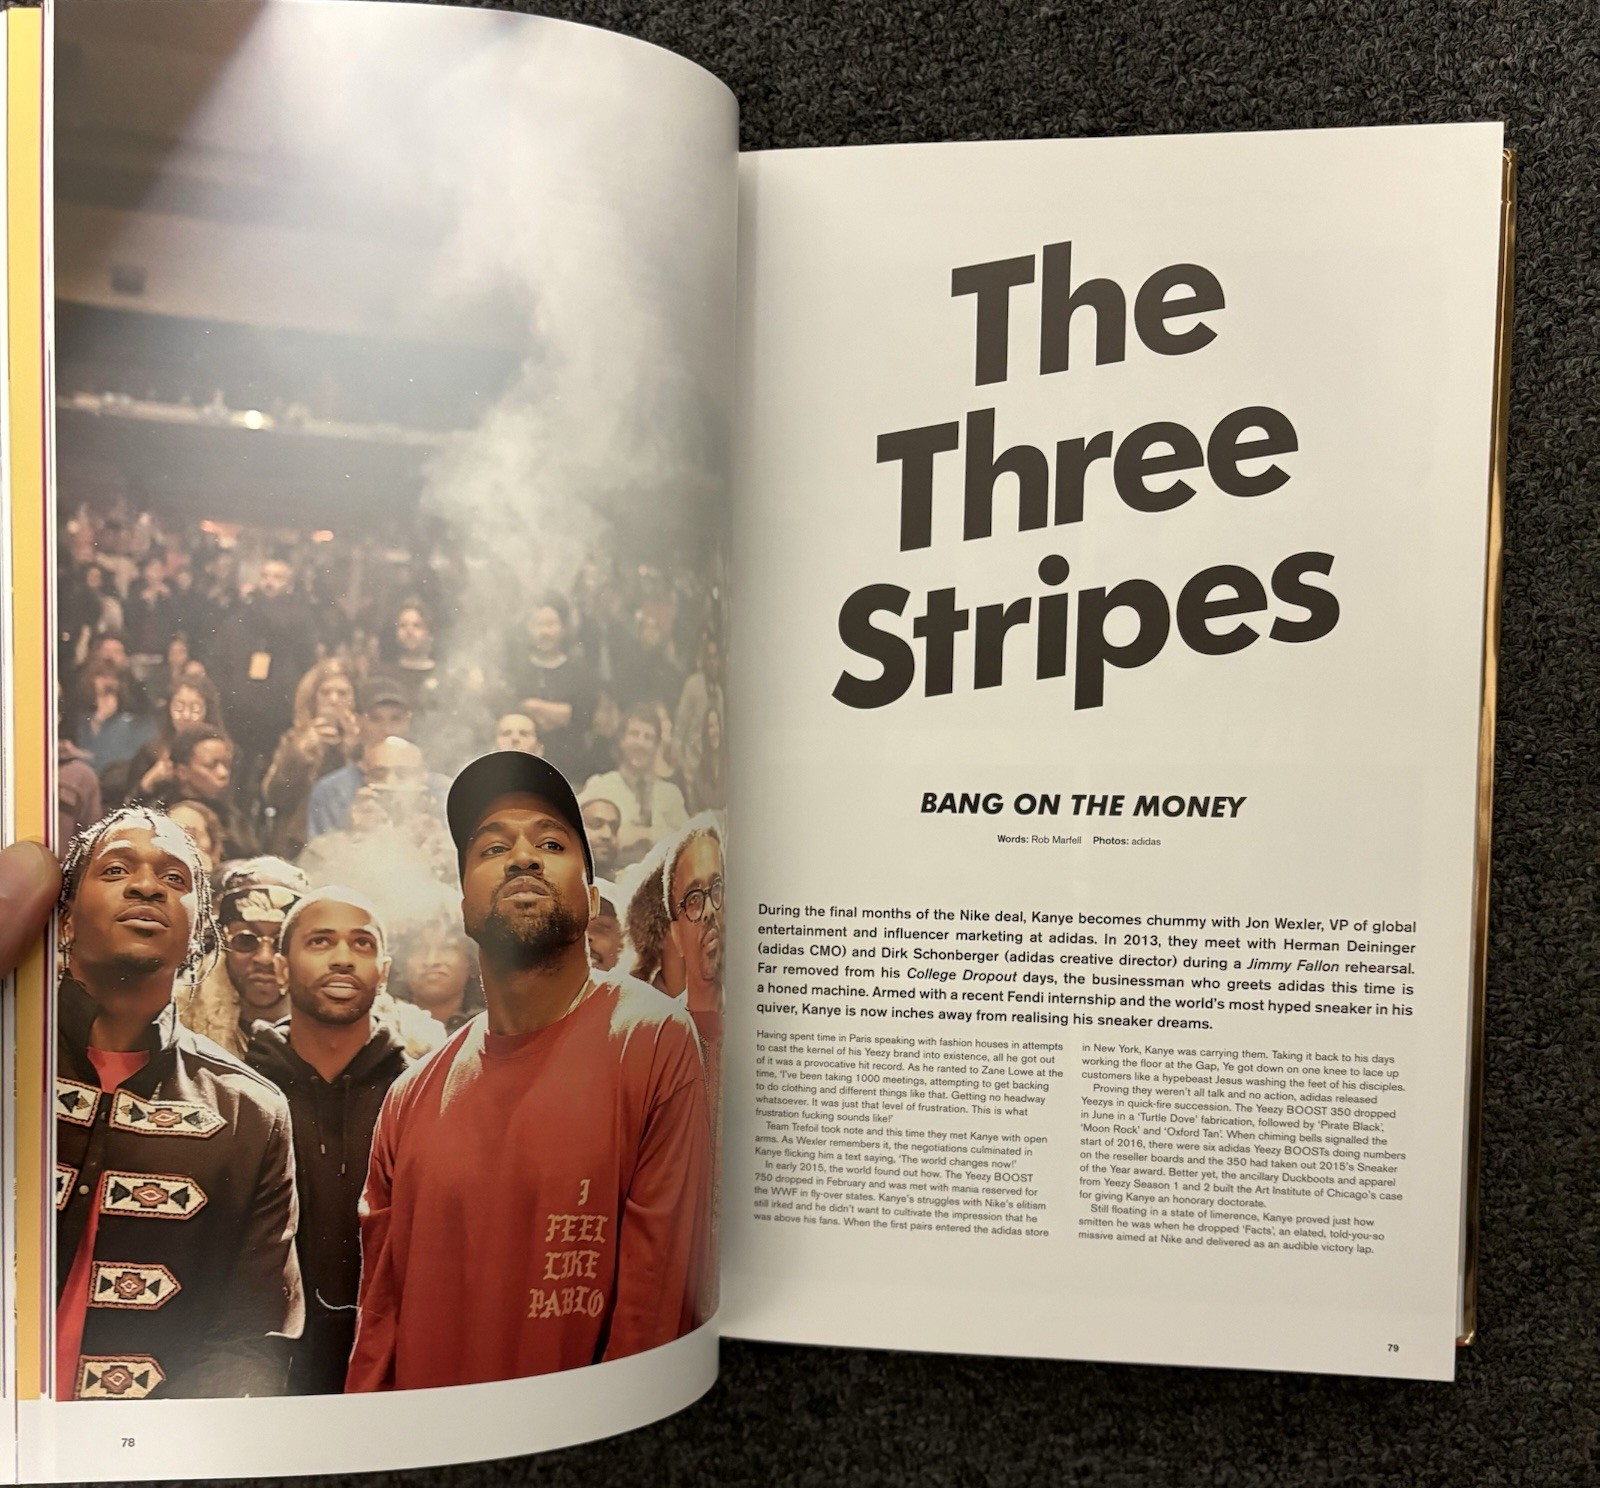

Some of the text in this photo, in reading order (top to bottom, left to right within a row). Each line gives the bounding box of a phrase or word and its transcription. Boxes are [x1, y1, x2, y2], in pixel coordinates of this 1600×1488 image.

[951, 240, 1226, 387] The
[876, 407, 1299, 552] Three
[831, 551, 1340, 711] Stripes
[920, 792, 1247, 817] BANG ON THE MONEY
[996, 833, 1161, 846] Words: Rob Marfell Photos: adidas
[758, 902, 1416, 936] During the final months of the Nike deal, Kanye becomes chummy with Jon Wexler, VP of global
[757, 922, 1416, 957] entertainment and influencer marketing at adidas. In 2013, they meet with Herman Deininger
[757, 941, 1415, 974] (adidas CMO) and Dirk Schonberger (adidas creative director) during a Jimmy Fallon rehearsal.
[757, 961, 1414, 995] Far removed from his College Dropout days, the businessman who greets adidas this time is
[756, 980, 1413, 1016] a honed machine. Armed with a recent Fendi internship and the world’s most hyped sneaker in his
[755, 1000, 1213, 1029] quiver, Kanye is now inches away from realising his sneaker dreams.
[756, 1029, 1063, 1053] Having spent time in Paris speaking with fashion houses in attempts
[1081, 1043, 1395, 1065] in New York, Kanye was carrying them. Taking it back to his days
[764, 1159, 1033, 1182] In early 2015, the world found out how. The Yeezy BOOST
[1079, 1150, 1398, 1173] on the reseller boards and the 350 had taken out 2015’s Sneaker
[545, 1213, 608, 1244] FEEL
[543, 1249, 600, 1280] LIKE
[527, 1285, 604, 1319] PABLO
[1387, 1343, 1399, 1352] 79
[121, 1437, 135, 1448] 78
